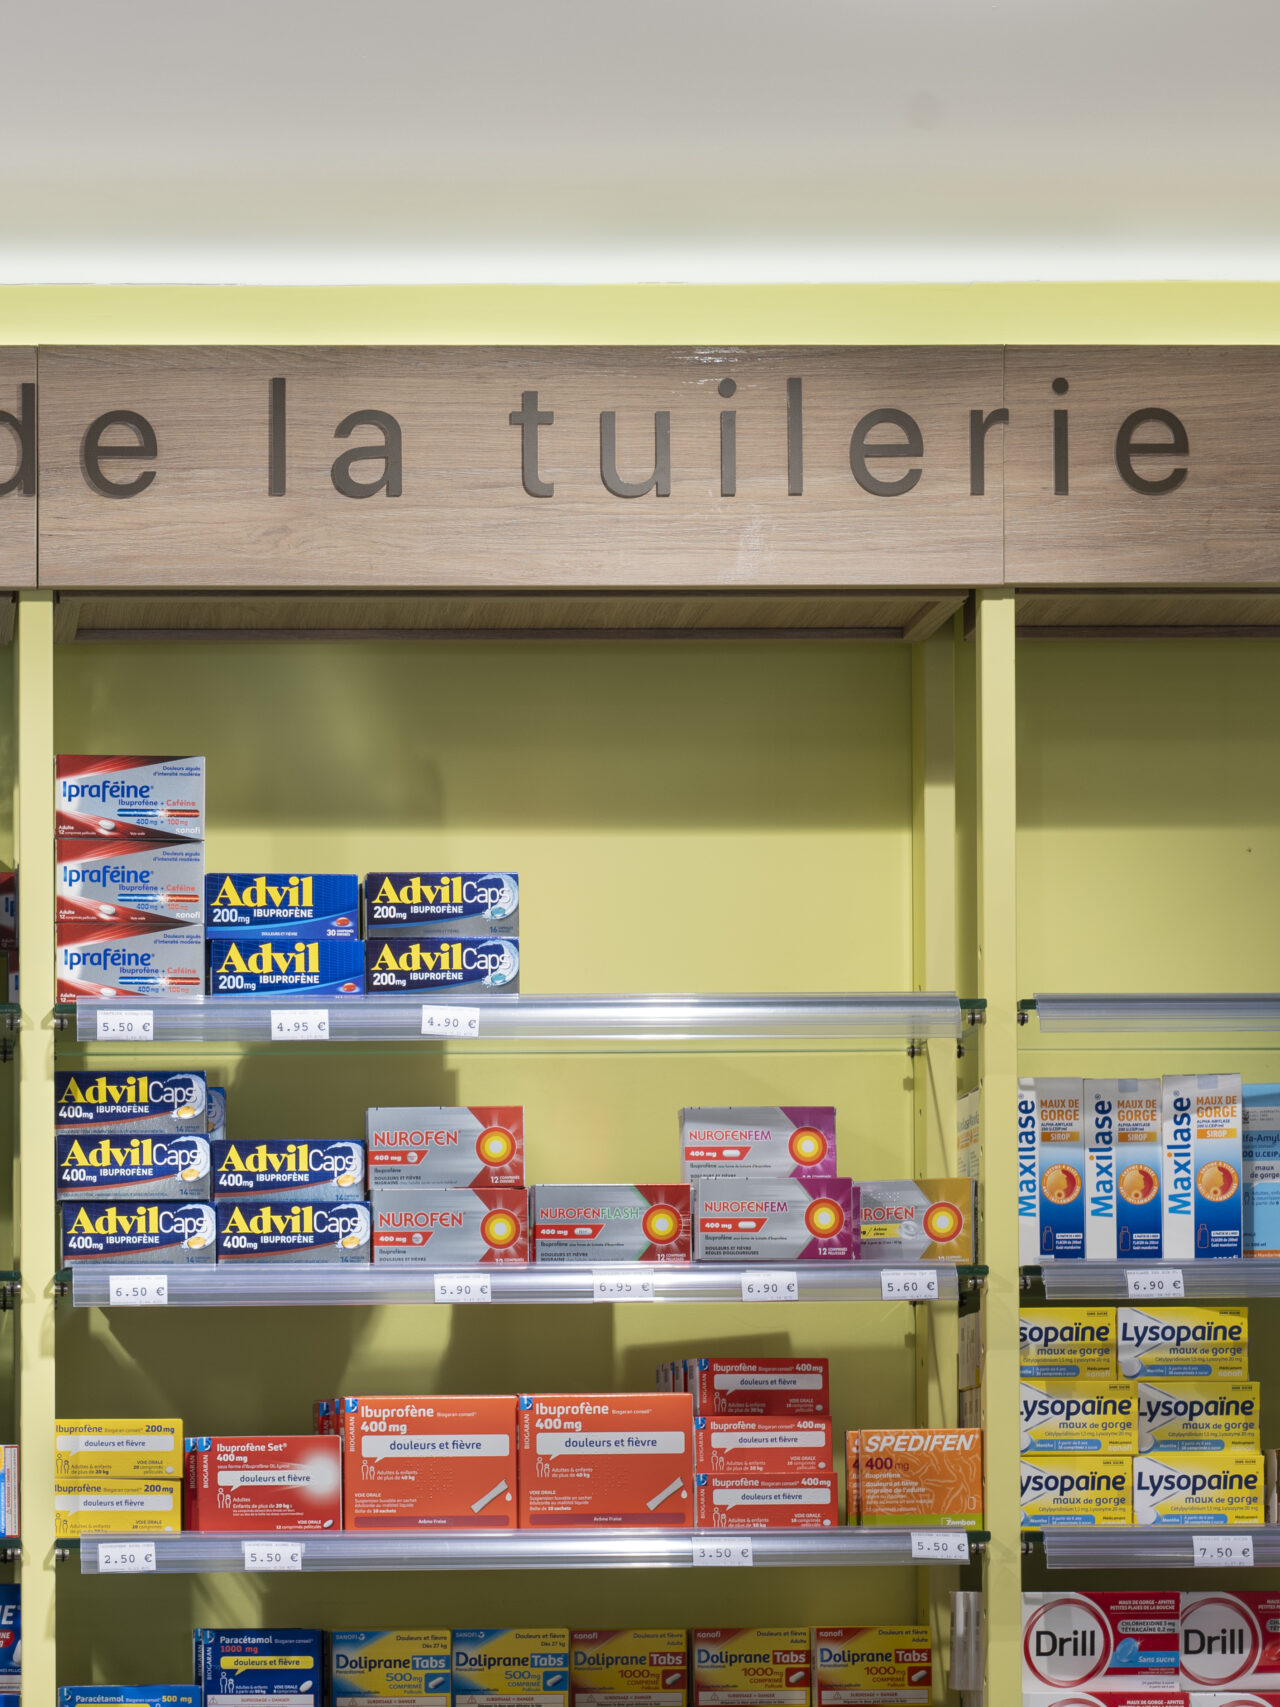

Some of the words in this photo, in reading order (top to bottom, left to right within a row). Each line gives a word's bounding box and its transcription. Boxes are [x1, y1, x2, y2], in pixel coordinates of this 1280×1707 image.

[269, 377, 403, 499] la
[509, 377, 1191, 499] tuilerie
[62, 780, 151, 803] Ipraféine
[63, 865, 151, 887] Ipraféine
[210, 876, 313, 907] Advil
[253, 906, 313, 919] IBUPROFÈNE
[64, 948, 152, 971] Ipraféine
[217, 942, 320, 974] Advil
[259, 972, 320, 985] IBUPROFÈNE
[102, 1021, 134, 1033] 5.50
[141, 1021, 151, 1033] €
[277, 1021, 310, 1033] 4.95
[317, 1021, 326, 1032] €
[427, 1017, 460, 1029] 4.90
[468, 1019, 477, 1030] €
[1041, 1099, 1066, 1109] MAUX
[1068, 1099, 1080, 1109] DE
[1196, 1096, 1222, 1105] MAUX
[1224, 1096, 1238, 1105] DE
[96, 1103, 150, 1114] IBUPROFÈNE
[1196, 1106, 1237, 1118] GORGE
[1041, 1110, 1080, 1121] GORGE
[373, 1130, 458, 1146] NUROFEN
[1050, 1132, 1070, 1141] SIROP
[1089, 1100, 1114, 1218] Maxilase
[1166, 1096, 1192, 1215] Maxilase
[379, 1212, 463, 1228] NUROFEN
[116, 1286, 147, 1297] 6.50
[156, 1286, 165, 1296] €
[440, 1285, 471, 1295] 5.90
[480, 1285, 488, 1295] €
[747, 1283, 778, 1294] 6.90
[786, 1283, 795, 1293] €
[887, 1282, 918, 1292] 5.60
[927, 1281, 935, 1291] €
[1133, 1280, 1164, 1290] 6.90
[1173, 1280, 1181, 1289] €
[1121, 1322, 1242, 1347] Lysopaïne
[1169, 1347, 1197, 1355] maux
[1211, 1347, 1243, 1357] gorge
[361, 1405, 434, 1419] Ibuprofène
[535, 1402, 609, 1417] Ibuprofène
[56, 1424, 102, 1435] Ibuprofène
[389, 1439, 436, 1449] douleurs
[439, 1440, 450, 1449] et
[452, 1439, 482, 1449] fièvre
[864, 1434, 974, 1453] SPEDIFEN
[865, 1457, 893, 1470] 400
[894, 1460, 910, 1472] mg
[240, 1474, 274, 1482] douleurs
[287, 1474, 311, 1482] fièvre
[1137, 1471, 1258, 1497] Lysopaïne
[917, 1541, 949, 1552] 5.50
[957, 1543, 966, 1553] €
[1199, 1548, 1233, 1558] 7.50
[1242, 1548, 1250, 1558] €
[104, 1554, 136, 1564] 2.50
[144, 1554, 153, 1563] €
[220, 1635, 273, 1645] Paracétamol
[1035, 1630, 1096, 1657] Drill
[1184, 1628, 1244, 1655] Drill
[336, 1655, 410, 1670] Doliprane
[412, 1656, 446, 1668] Tabs
[820, 1649, 893, 1665] Doliprane
[895, 1650, 928, 1662] Tabs
